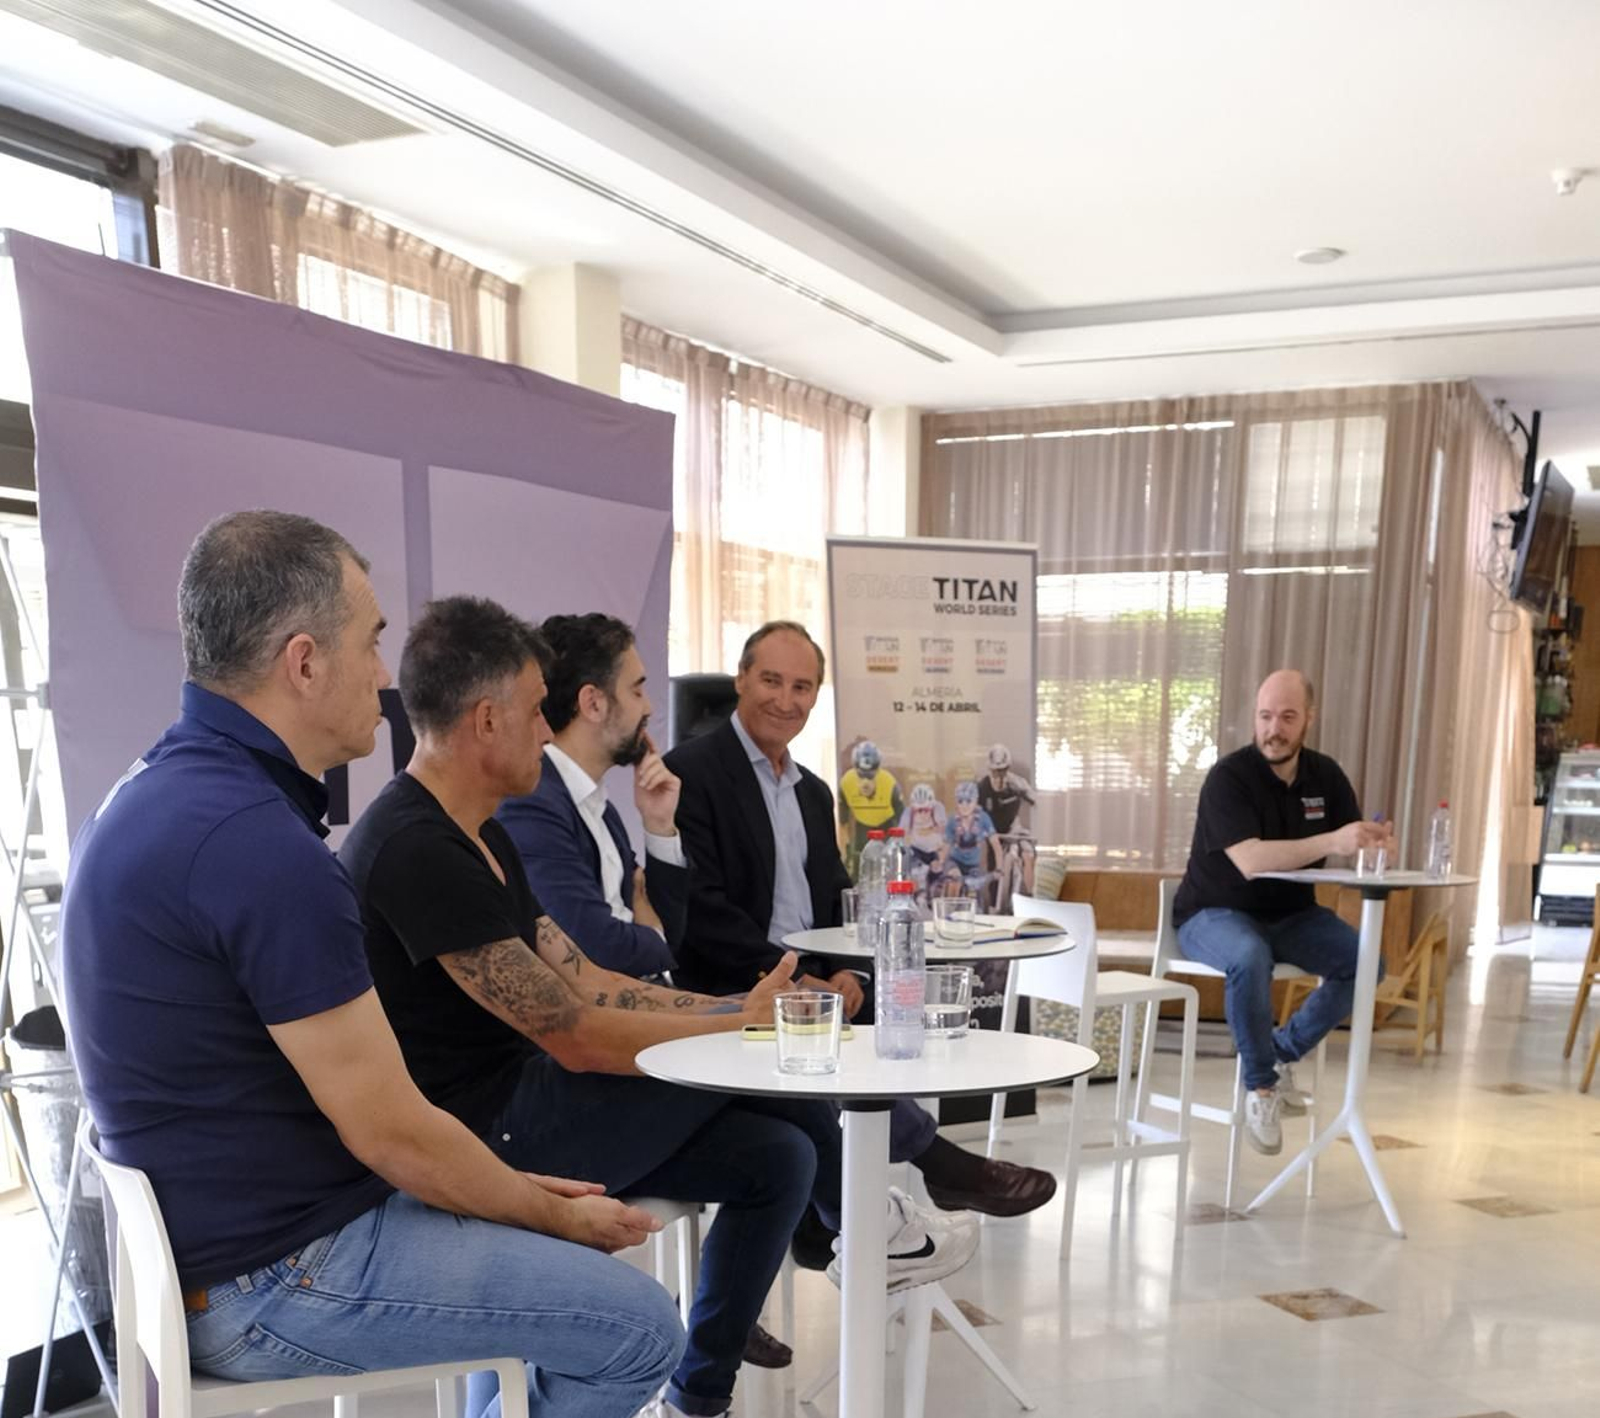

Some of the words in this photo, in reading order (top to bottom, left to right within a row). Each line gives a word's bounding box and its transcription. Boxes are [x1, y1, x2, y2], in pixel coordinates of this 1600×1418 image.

[932, 576, 1018, 603] TITAN
[934, 603, 976, 615] WORLD
[978, 604, 1018, 616] SERIES
[893, 701, 904, 712] 12
[915, 701, 926, 712] 14
[929, 701, 944, 712] DE
[947, 702, 982, 713] ABRIL
